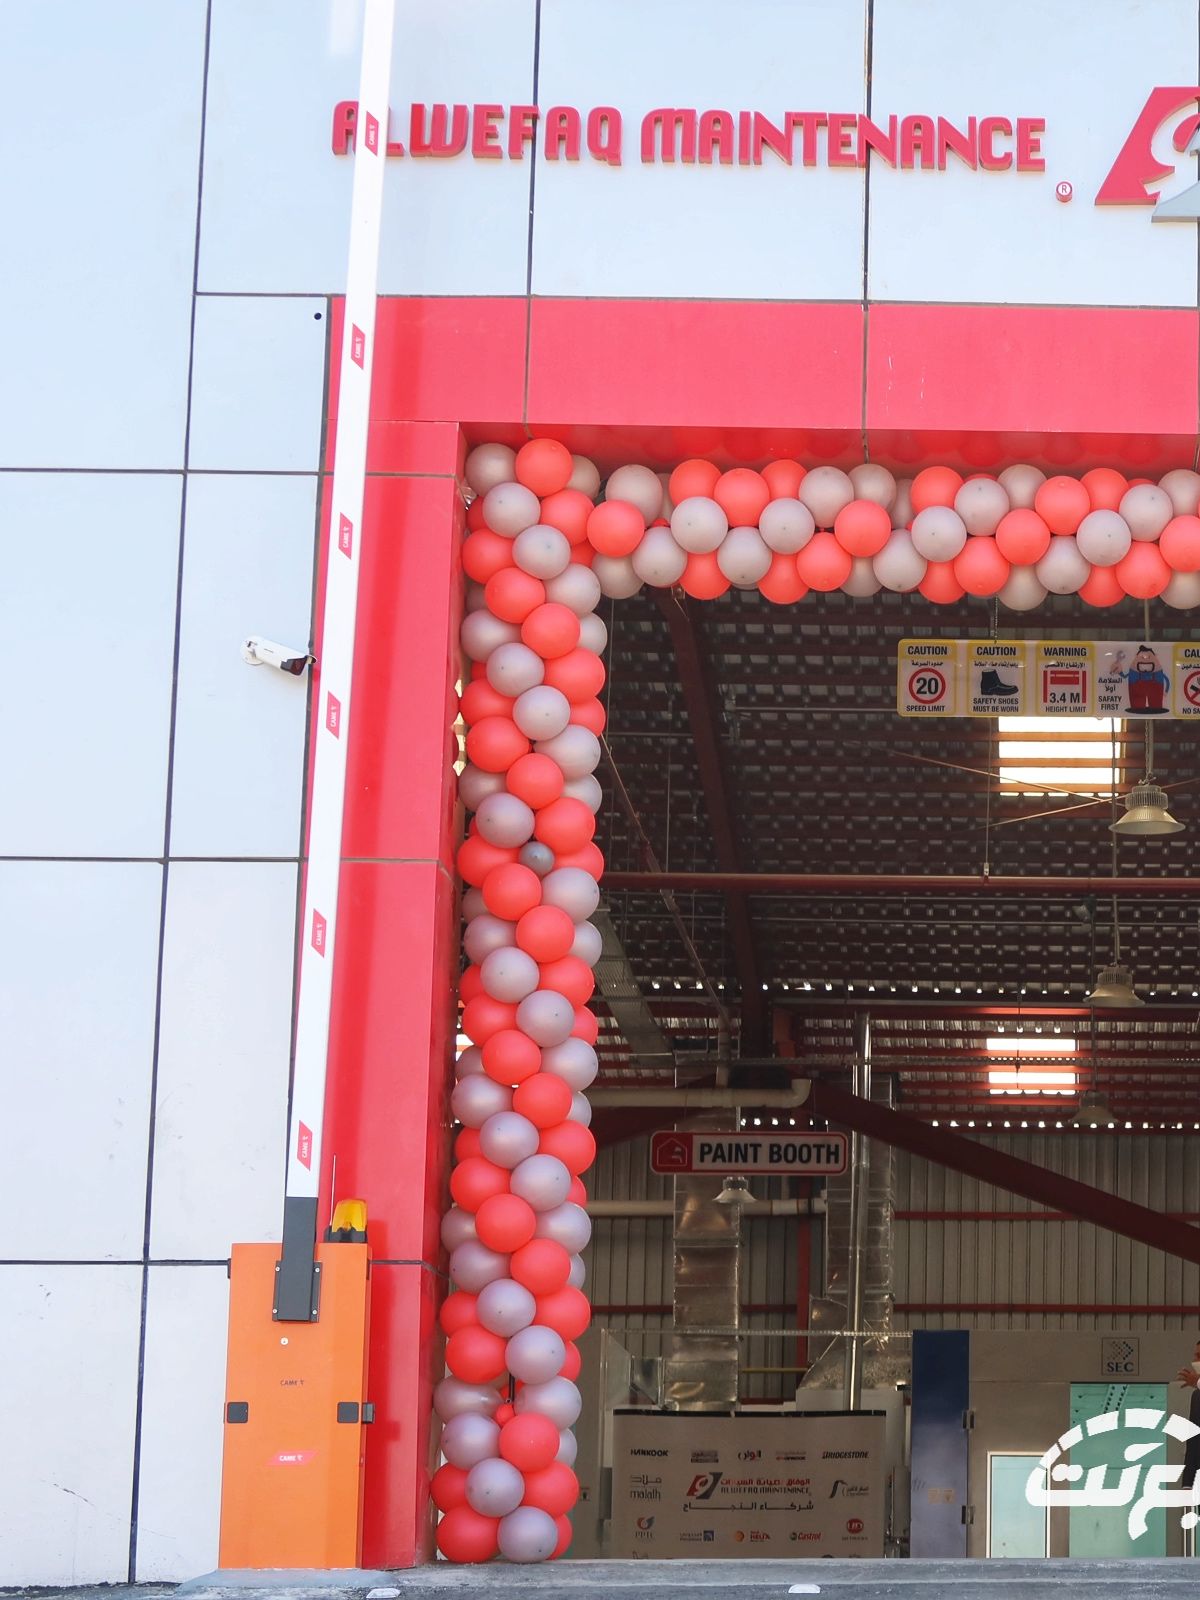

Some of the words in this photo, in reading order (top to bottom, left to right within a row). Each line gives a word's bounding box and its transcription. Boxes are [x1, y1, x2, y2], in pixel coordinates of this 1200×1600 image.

[641, 106, 1046, 172] MAINTENANCE
[907, 646, 948, 656] CAUTION
[976, 646, 1016, 656] CAUTION
[1044, 647, 1087, 657] WARNING
[916, 677, 939, 695] 20
[1050, 692, 1066, 704] 3.4
[1070, 692, 1080, 704] M
[699, 1142, 762, 1164] PAINT
[768, 1143, 840, 1164] BOOTH
[1107, 1361, 1134, 1372] SEC
